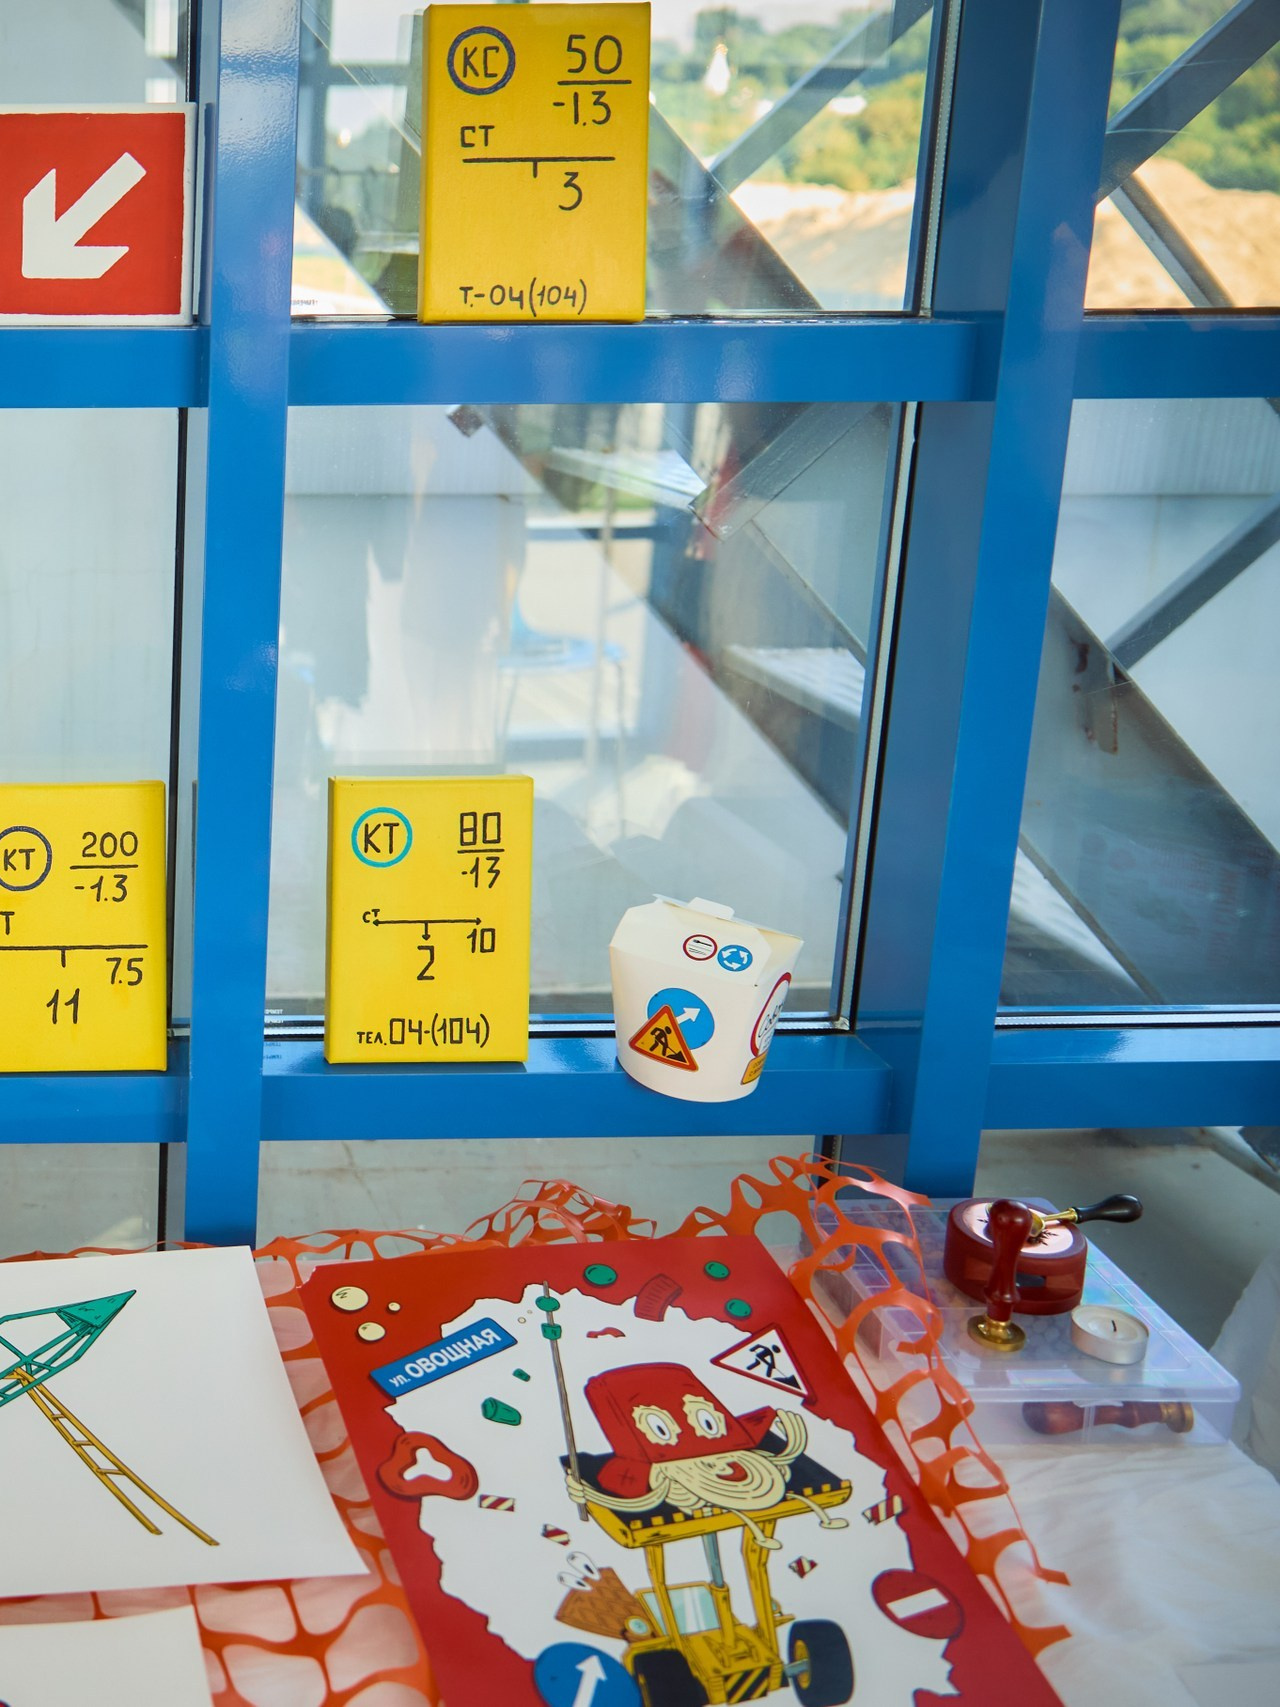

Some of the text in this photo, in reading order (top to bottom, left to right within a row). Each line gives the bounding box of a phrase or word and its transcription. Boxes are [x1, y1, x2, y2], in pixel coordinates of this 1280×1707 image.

[462, 46, 499, 78] КС
[566, 34, 622, 74] 50
[552, 91, 612, 126] -1.3
[460, 124, 495, 148] СТ
[558, 171, 582, 211] 3
[81, 830, 138, 859] 200
[364, 822, 400, 854] КТ
[459, 812, 501, 846] 80
[3, 848, 36, 871] КТ
[73, 874, 128, 903] -1.3
[466, 928, 496, 953] 10
[105, 957, 144, 986] 7.5
[416, 945, 435, 981] 2
[45, 988, 81, 1025] 11
[389, 1328, 502, 1388] ул. ОВОЩНАЯ
